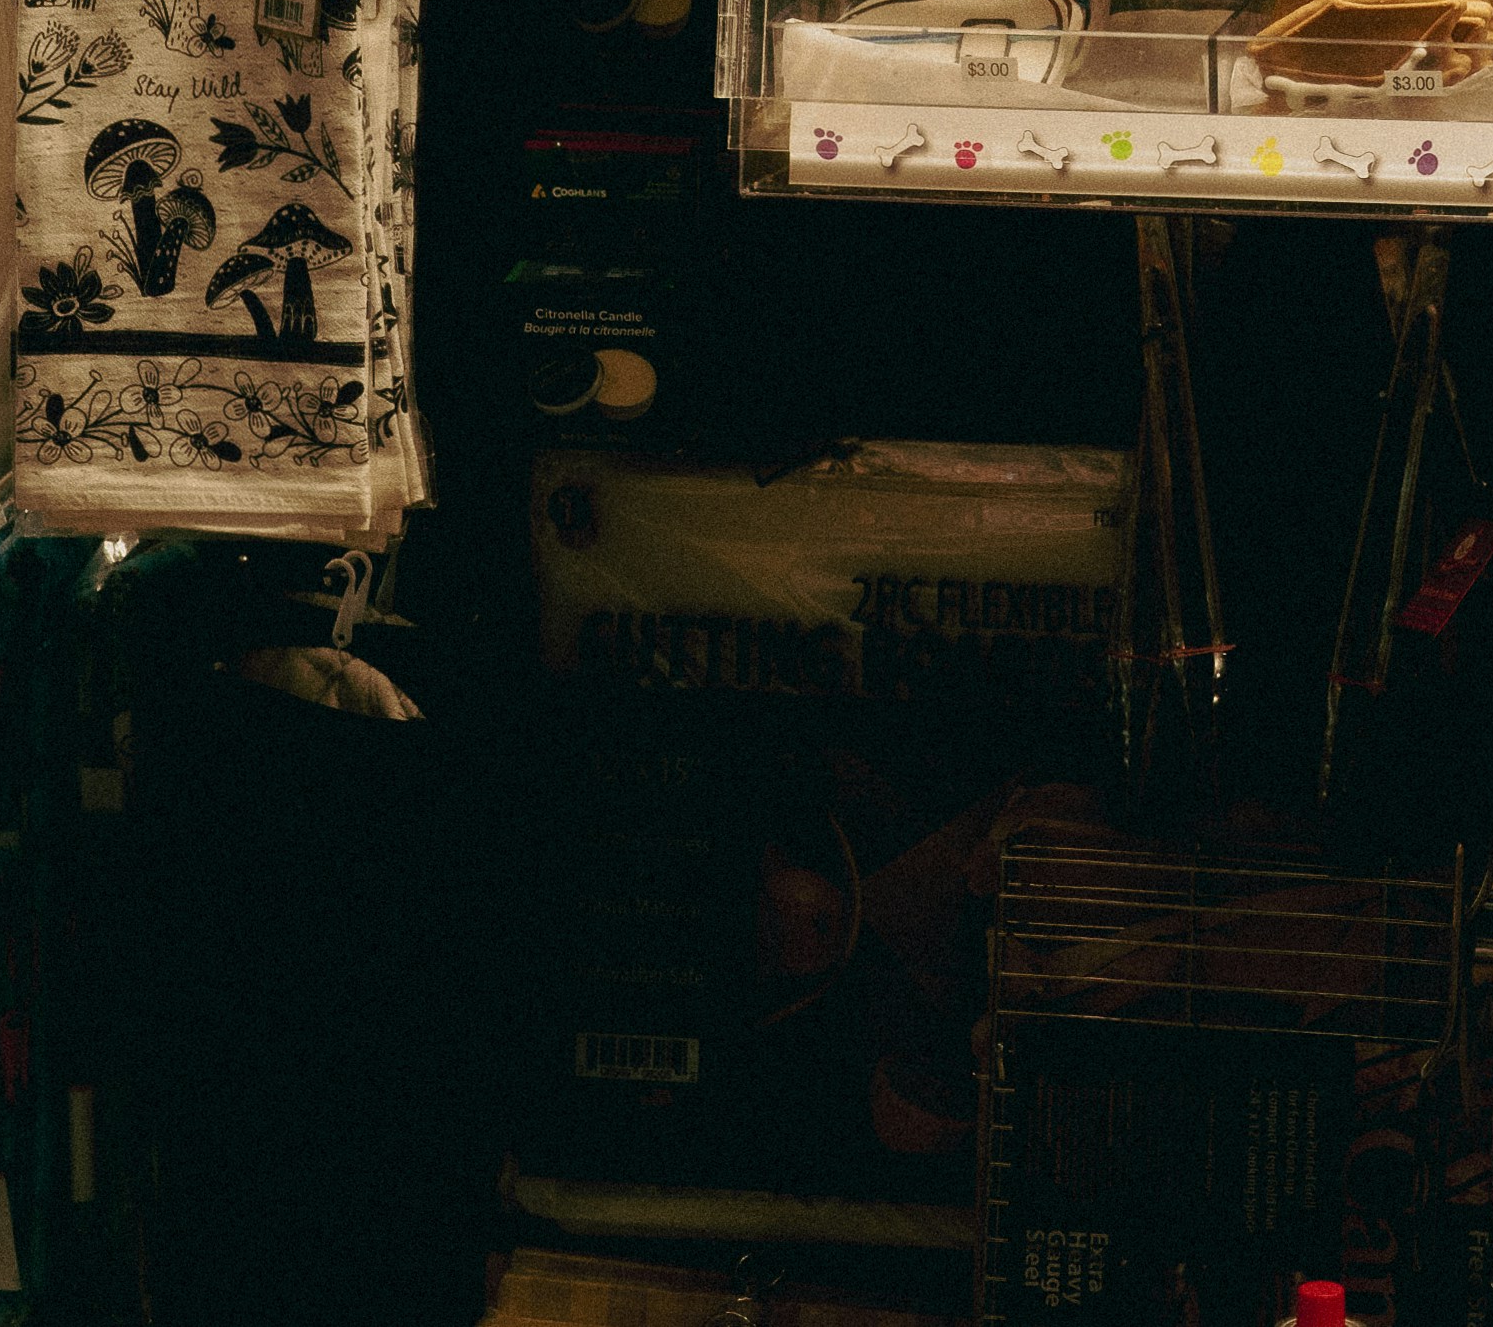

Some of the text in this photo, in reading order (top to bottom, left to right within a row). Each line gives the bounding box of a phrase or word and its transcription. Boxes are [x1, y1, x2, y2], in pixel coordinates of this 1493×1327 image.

[966, 60, 1011, 79] $3.00
[132, 70, 247, 100] Stay Wild
[1390, 74, 1437, 95] $3.00
[533, 308, 644, 324] Citronella Candle
[1068, 1228, 1089, 1307] Heavy
[1088, 1230, 1108, 1295] Extra
